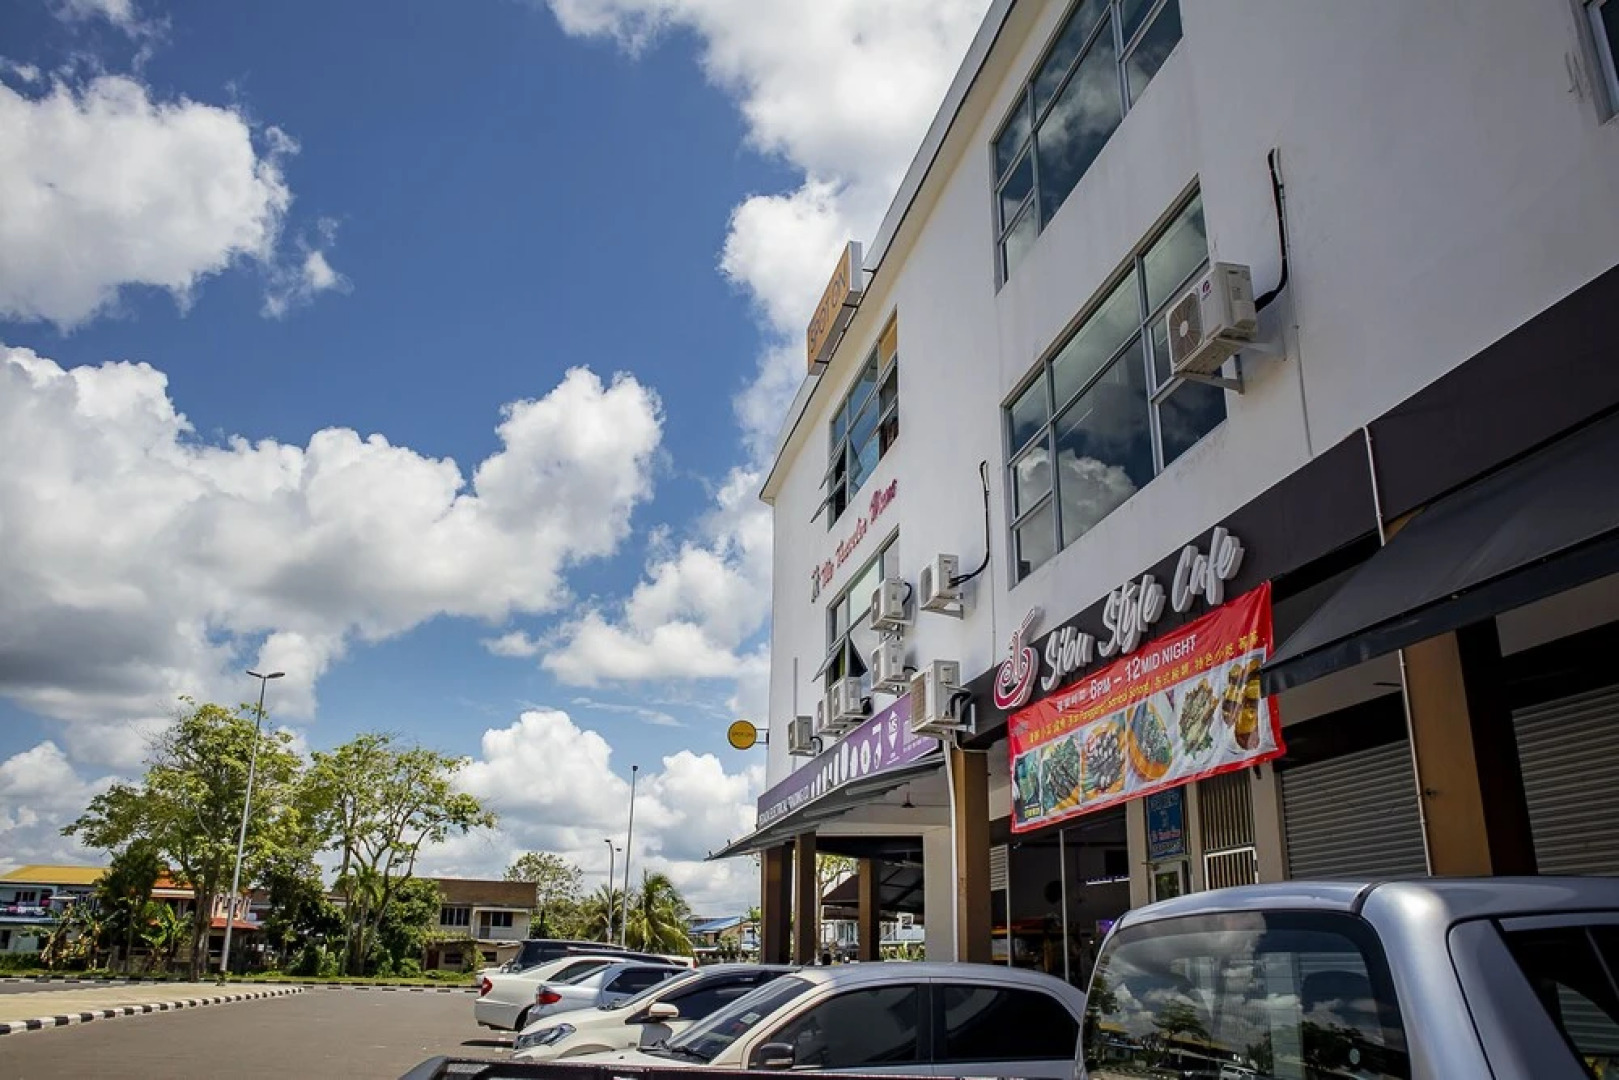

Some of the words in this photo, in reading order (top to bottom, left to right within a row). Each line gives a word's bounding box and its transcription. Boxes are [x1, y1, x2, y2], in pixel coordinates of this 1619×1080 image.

[1041, 626, 1095, 691] Sibu
[1098, 575, 1166, 657] Style
[1172, 526, 1245, 612] Cafe
[1090, 678, 1111, 700] 6PM
[1161, 634, 1197, 665] NIGHT
